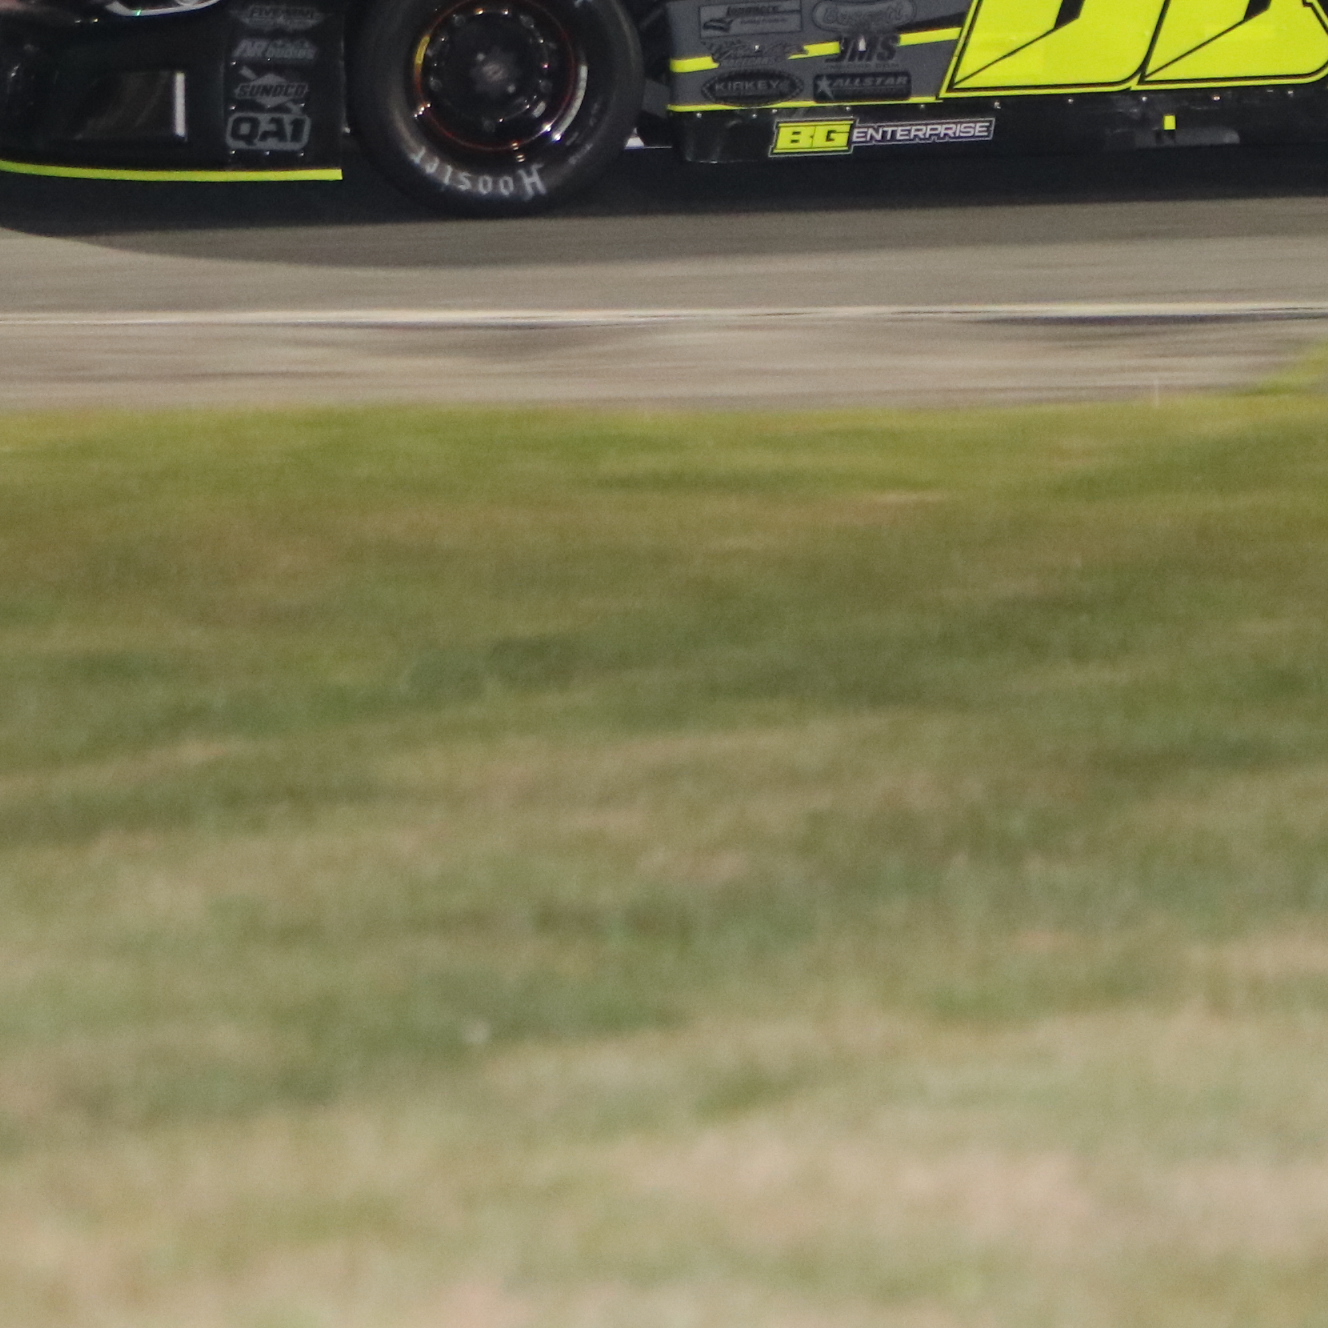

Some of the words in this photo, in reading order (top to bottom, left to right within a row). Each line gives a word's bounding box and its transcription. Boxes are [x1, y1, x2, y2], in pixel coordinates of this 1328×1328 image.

[239, 83, 308, 98] SUNOCO
[716, 79, 780, 92] KIRKEY
[832, 75, 908, 86] ALLSTAR
[231, 116, 307, 146] QA1
[773, 120, 854, 153] BG
[852, 122, 991, 143] ENTERPRISE
[409, 146, 548, 200] Hoosier
